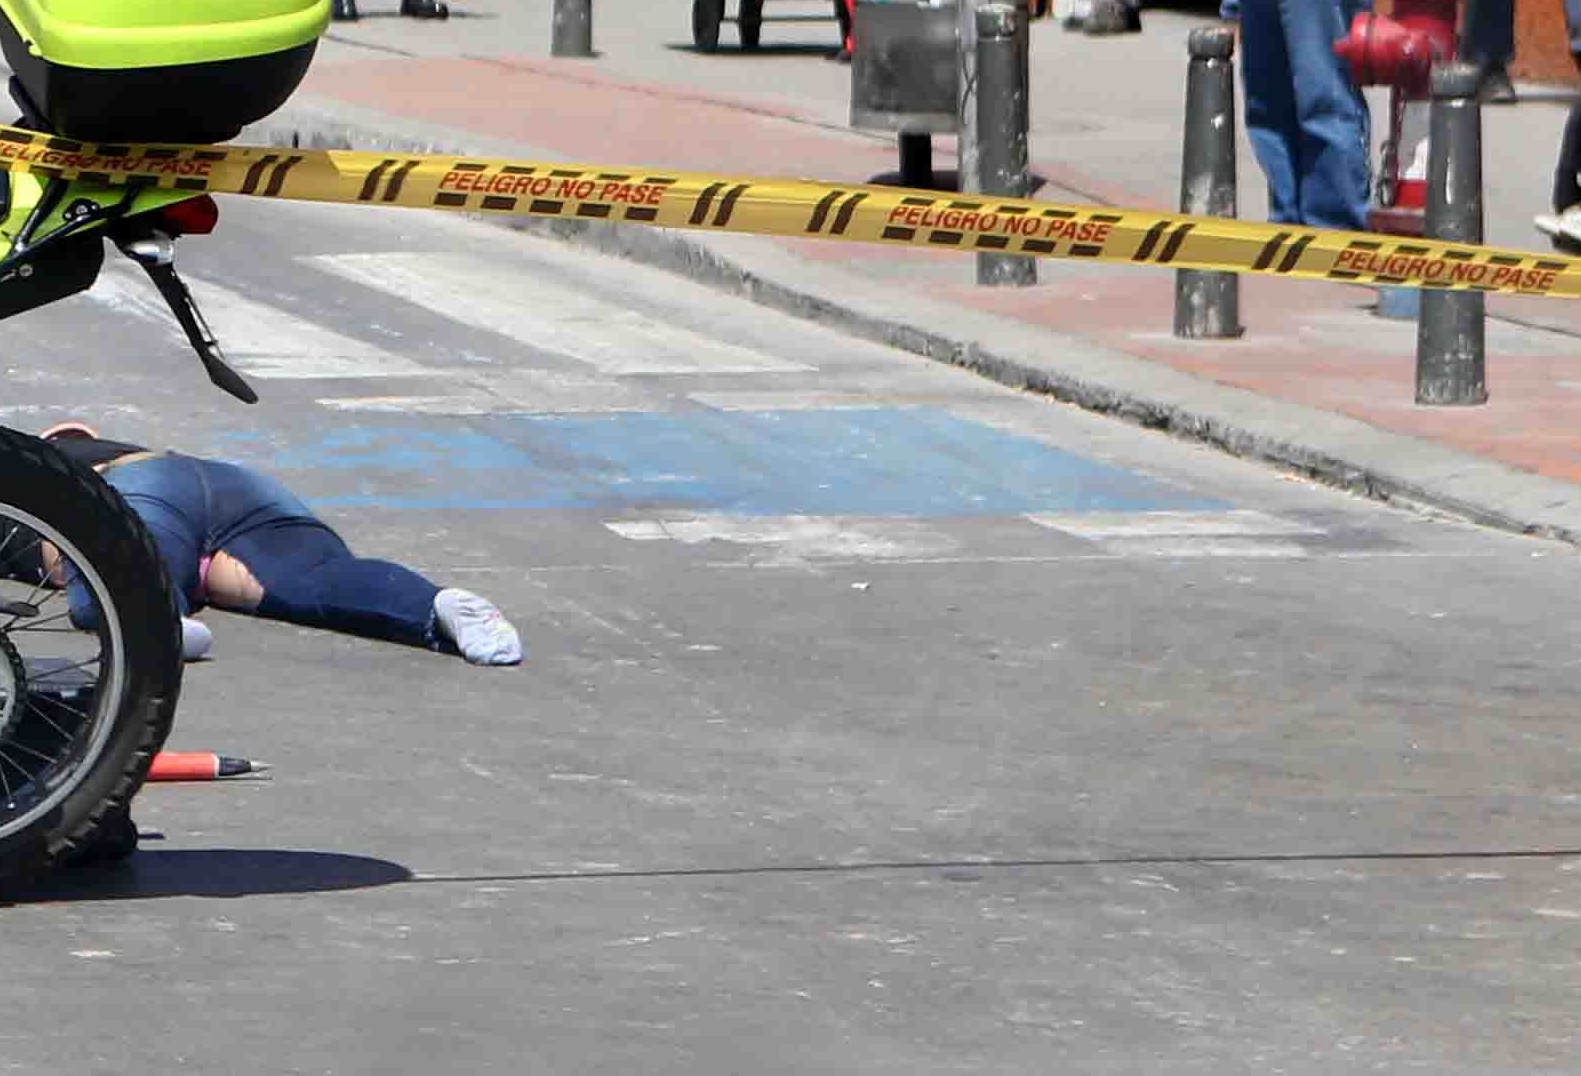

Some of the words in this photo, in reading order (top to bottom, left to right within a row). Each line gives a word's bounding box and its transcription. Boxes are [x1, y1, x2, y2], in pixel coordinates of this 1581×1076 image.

[438, 171, 552, 197] PELIGRO
[555, 178, 595, 200] NO
[599, 182, 668, 205] PASE
[887, 205, 999, 232] PELIGRO
[1001, 214, 1043, 237] NO
[1045, 219, 1112, 243] PASE
[1332, 249, 1445, 279] PELIGRO
[1449, 258, 1489, 282] NO
[1490, 264, 1556, 290] PASE
